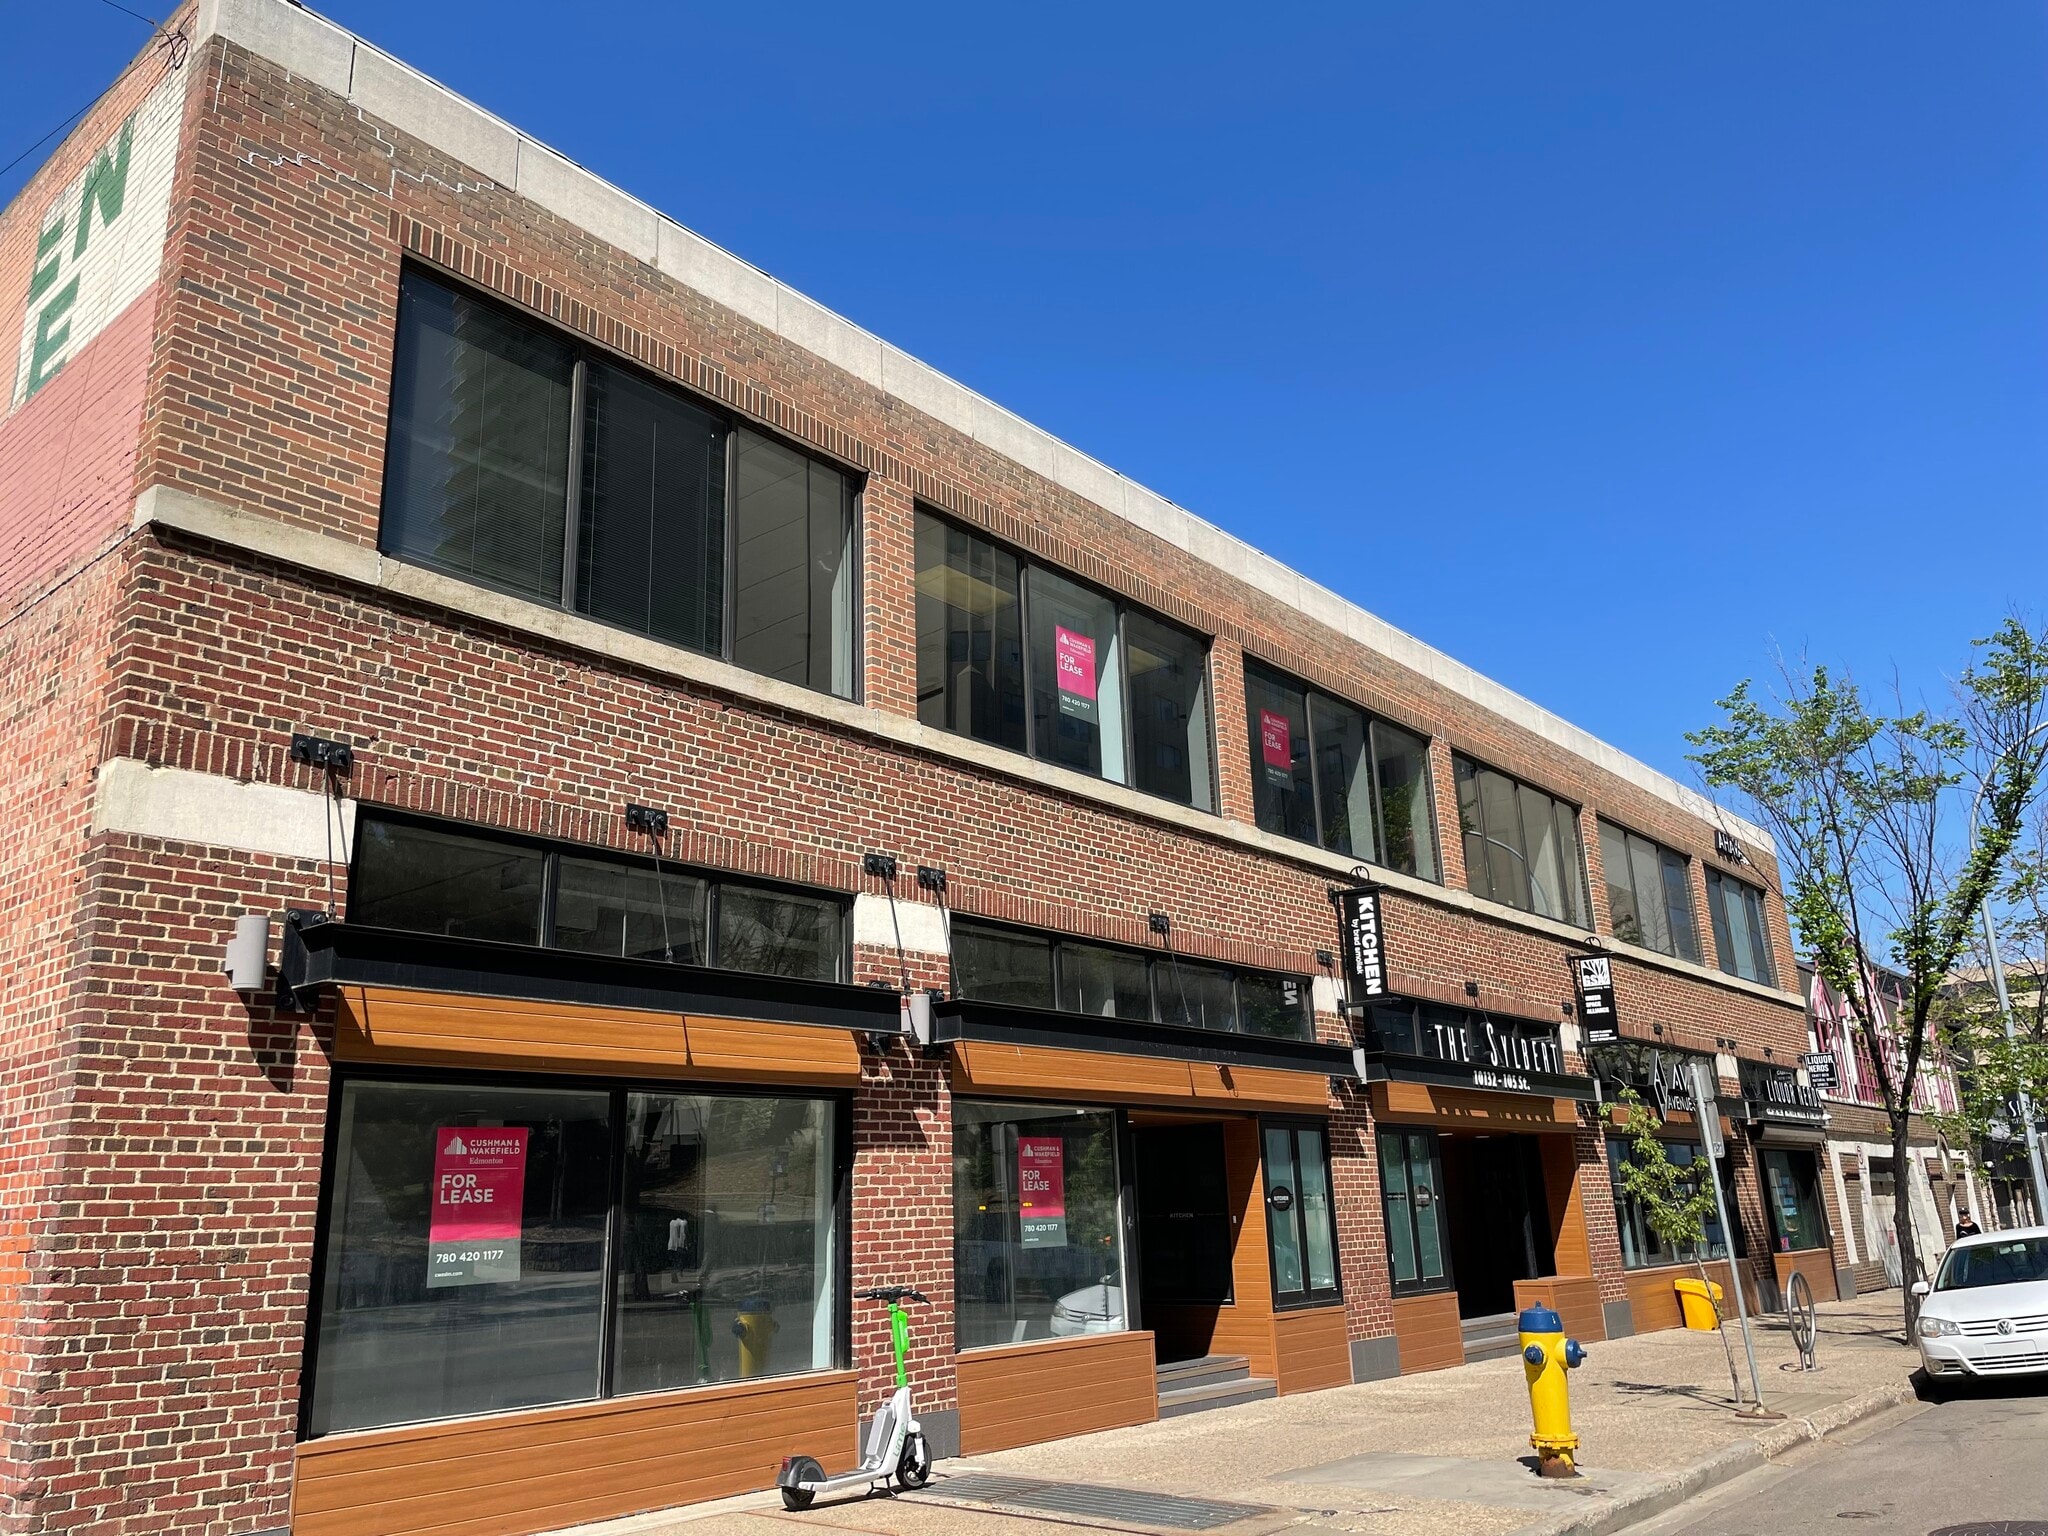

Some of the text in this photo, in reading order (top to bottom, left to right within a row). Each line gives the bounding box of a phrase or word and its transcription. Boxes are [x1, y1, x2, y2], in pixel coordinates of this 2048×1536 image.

[1060, 652, 1075, 665] FOR
[1060, 663, 1083, 676] LEASE
[1062, 695, 1071, 703] 780
[1072, 699, 1080, 707] 420
[1264, 731, 1276, 741] FOR
[1264, 738, 1282, 751] LEASE
[1351, 918, 1359, 928] by
[1353, 929, 1361, 946] brad
[1358, 897, 1382, 995] KITCHEN
[1434, 1024, 1469, 1062] THE
[1806, 1055, 1834, 1065] LIQUOR
[1808, 1064, 1830, 1073] NERDS
[1766, 1079, 1797, 1105] LIQUOR
[470, 1139, 520, 1147] CUSHMAN &
[470, 1147, 520, 1155] WAKEFIELD
[469, 1157, 504, 1165] Edmonton
[1022, 1170, 1040, 1180] FOR
[441, 1174, 477, 1189] FOR
[1023, 1181, 1050, 1191] LEASE
[440, 1188, 494, 1204] LEASE
[1035, 1224, 1047, 1232] 420
[1047, 1223, 1058, 1231] 1177
[436, 1250, 504, 1264] 780 420 1177
[893, 1423, 905, 1457] Lime
